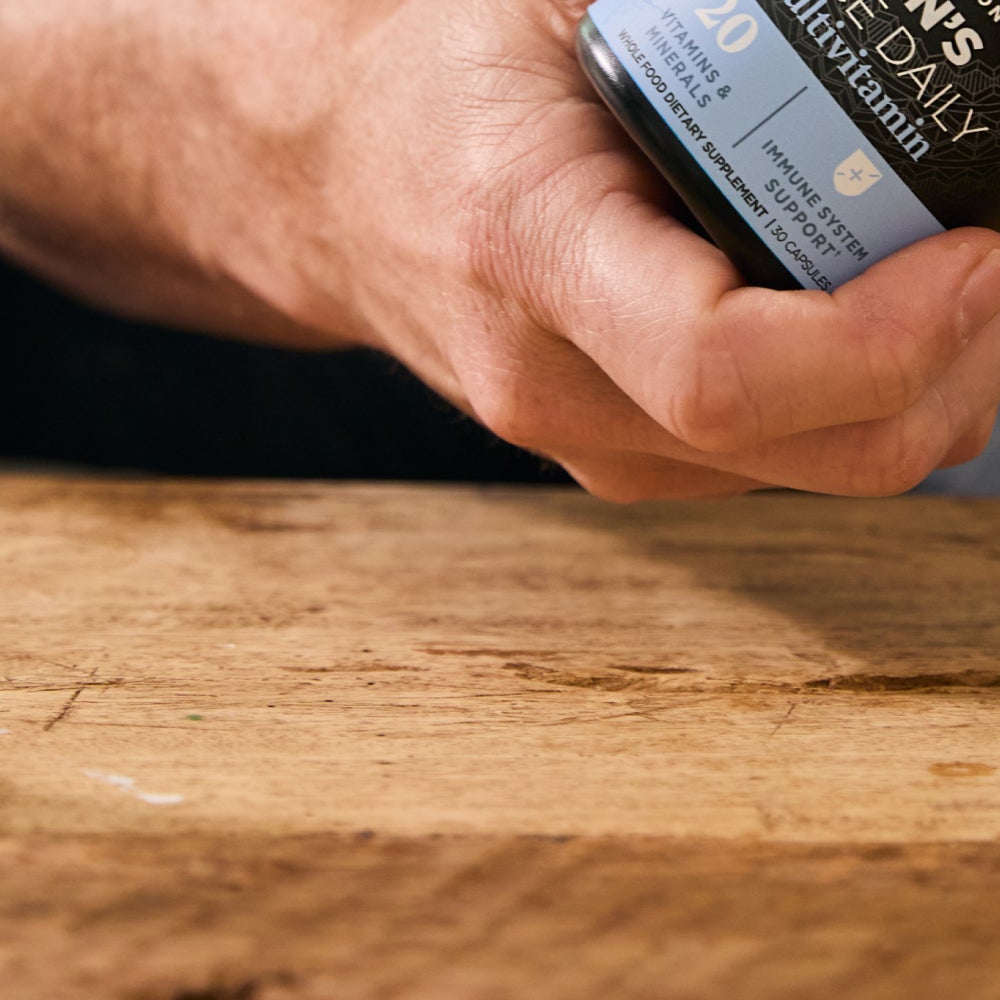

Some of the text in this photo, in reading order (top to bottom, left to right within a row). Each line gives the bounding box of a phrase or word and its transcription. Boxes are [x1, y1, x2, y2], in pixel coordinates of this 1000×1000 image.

[645, 25, 712, 108] MINERALS
[660, 8, 732, 100] VITAMINS &
[875, 25, 990, 142] DAILY
[618, 27, 645, 64] WHOLE
[640, 61, 668, 93] FOOD
[663, 91, 707, 142] DIETARY
[702, 141, 769, 218] SUPPLEMENT
[771, 224, 788, 242] 30
[784, 241, 832, 291] CAPSULES
[761, 139, 870, 262] IMMUNE SYSTEM
